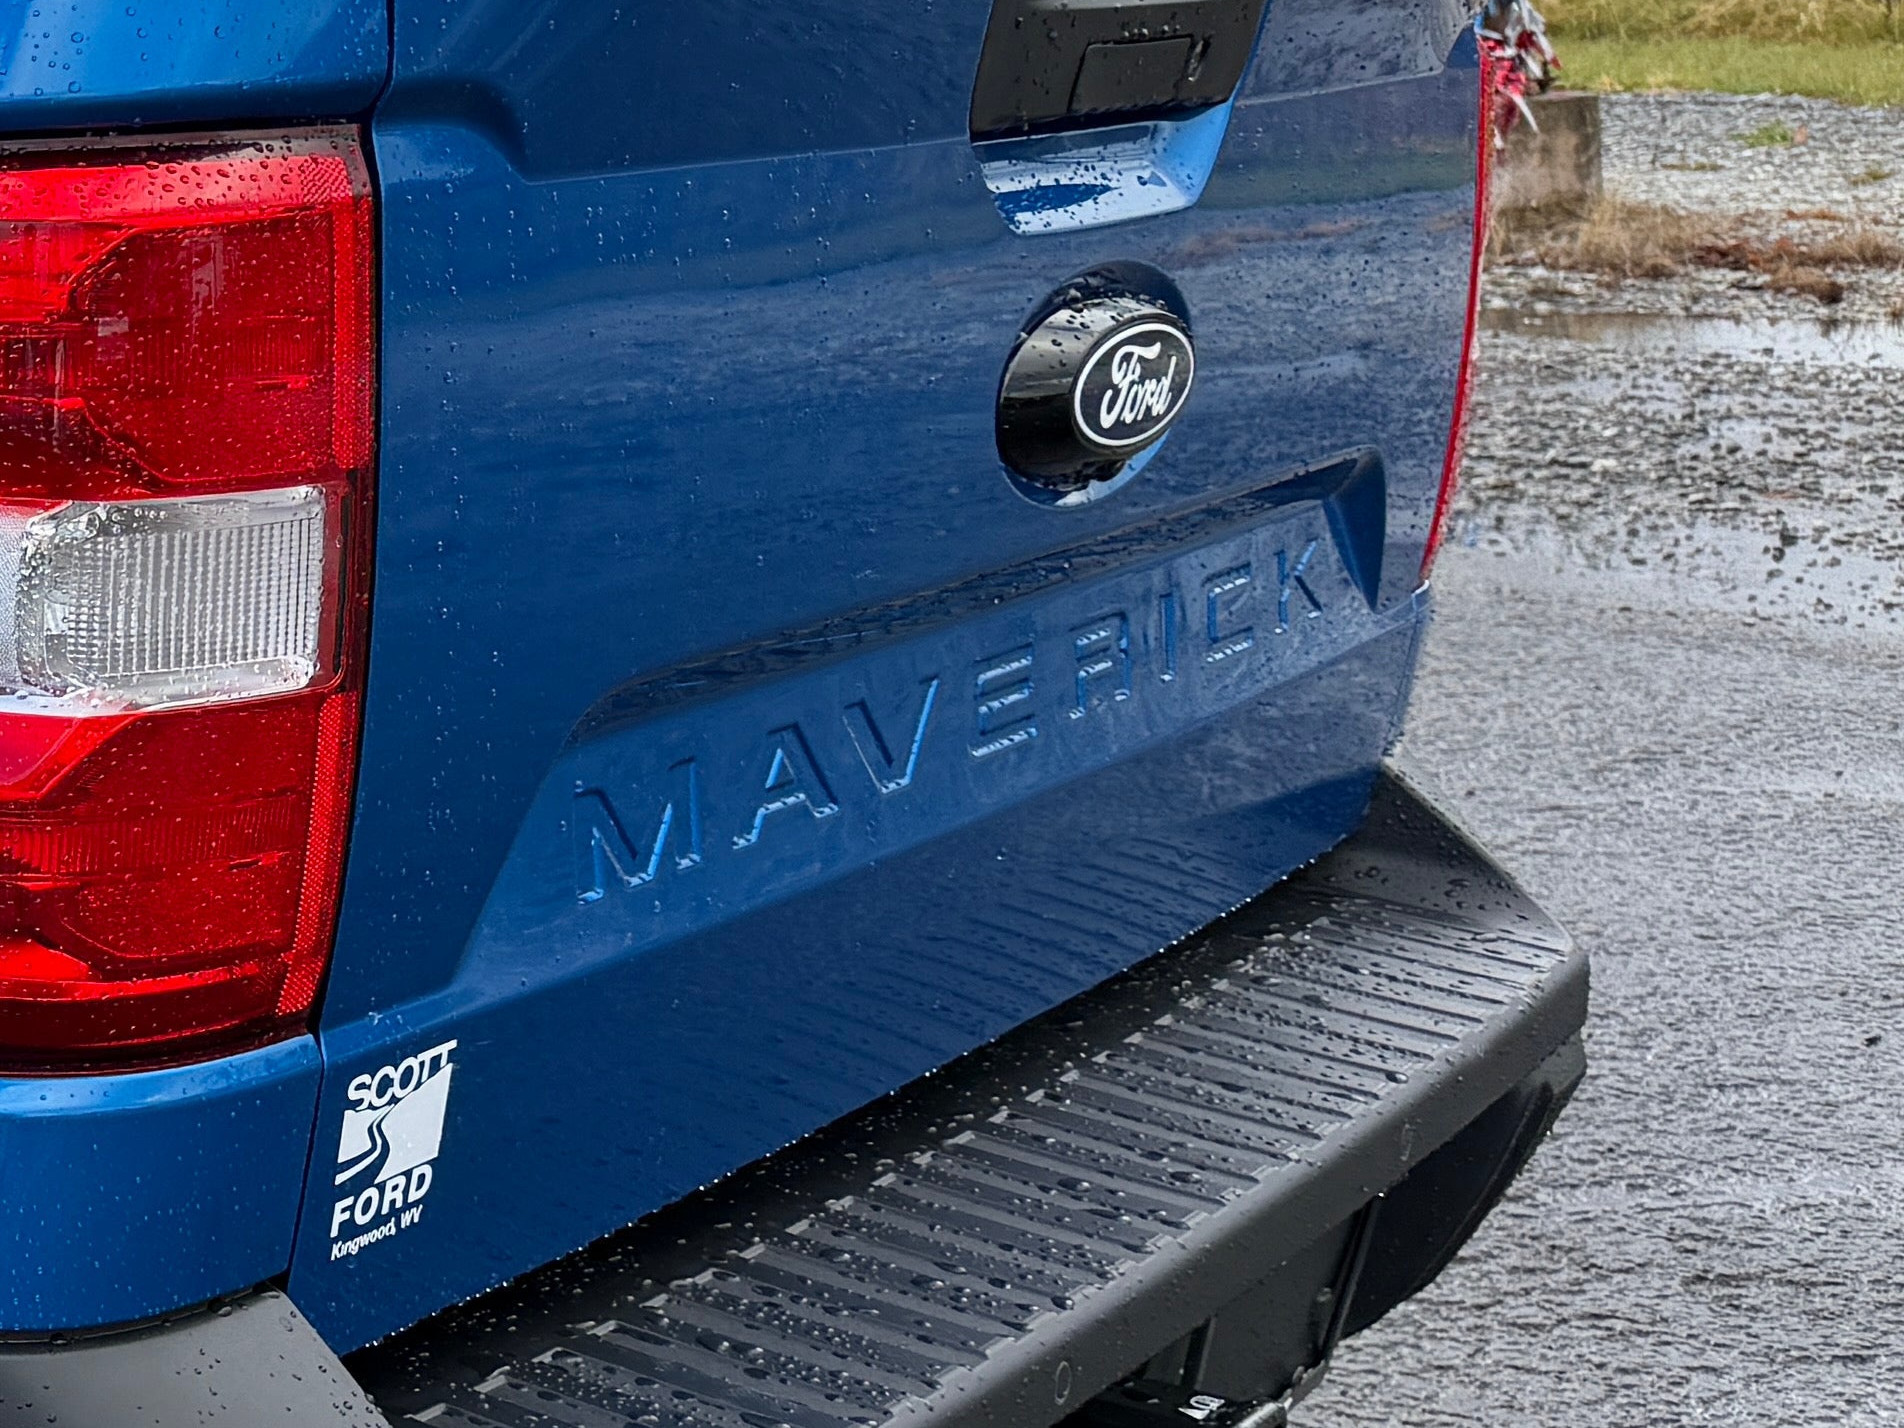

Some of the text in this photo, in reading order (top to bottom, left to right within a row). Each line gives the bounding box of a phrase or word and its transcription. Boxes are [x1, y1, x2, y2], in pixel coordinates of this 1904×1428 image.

[1100, 341, 1177, 429] Ford
[573, 537, 1324, 905] MAVERICK
[347, 1039, 458, 1111] SCOTT
[330, 1164, 433, 1238] FORD
[400, 1204, 423, 1229] WV
